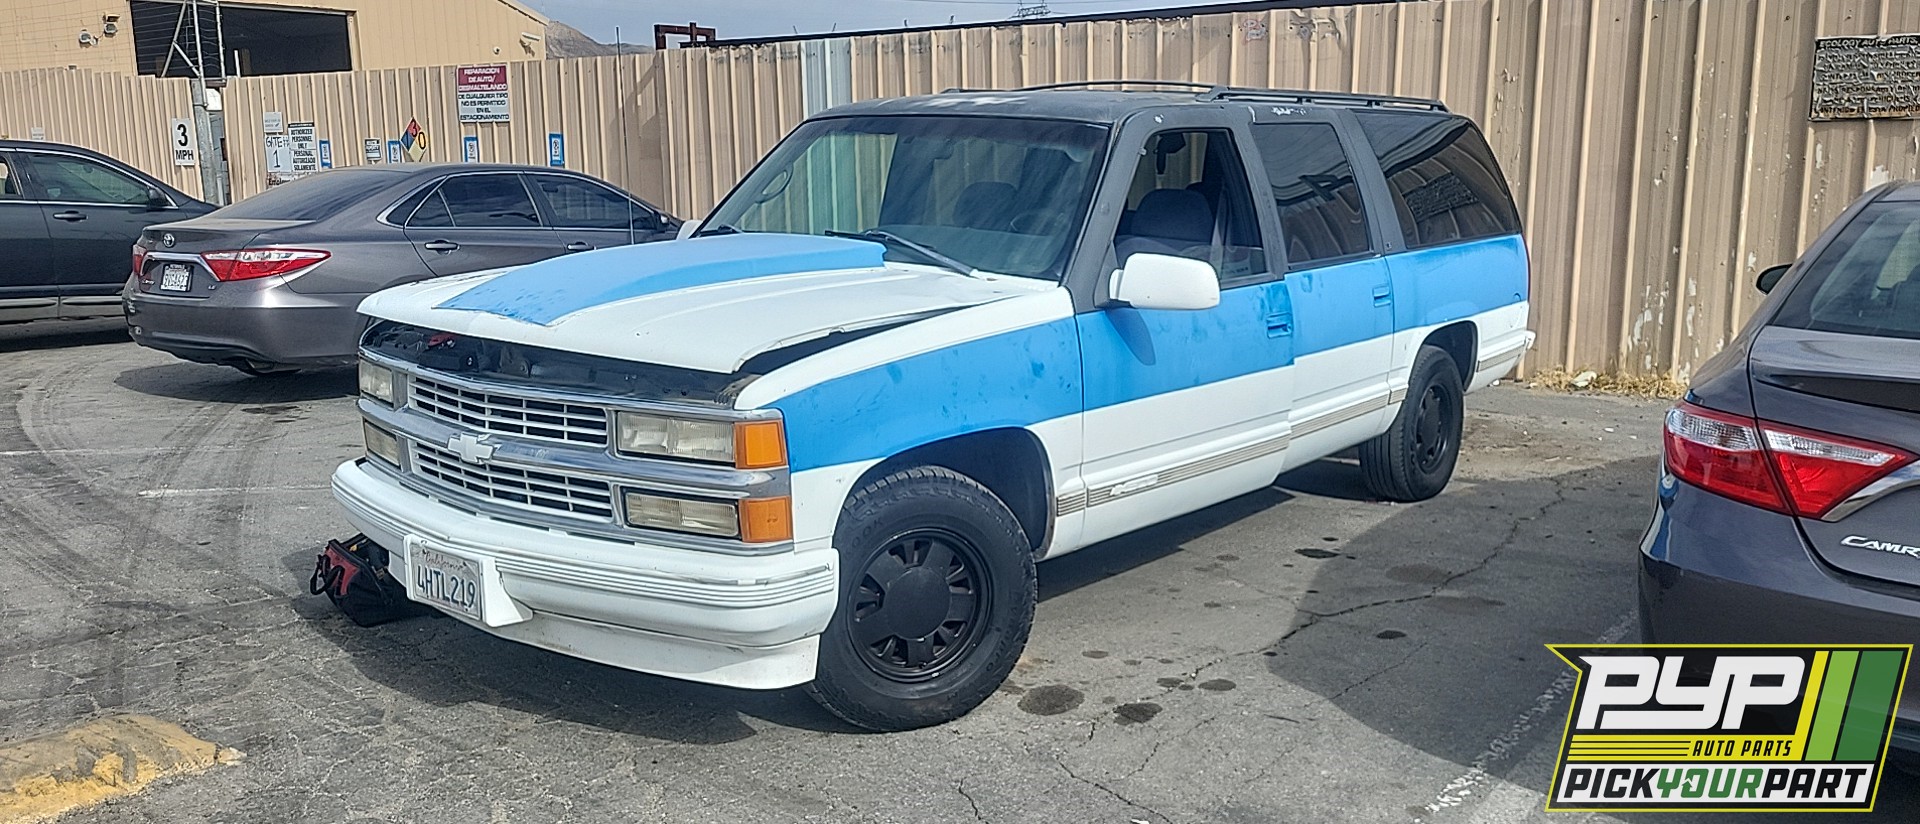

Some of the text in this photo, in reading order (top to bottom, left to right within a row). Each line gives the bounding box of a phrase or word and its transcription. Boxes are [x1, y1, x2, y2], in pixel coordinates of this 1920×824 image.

[1819, 40, 1860, 48] ECOLOGY
[177, 123, 188, 147] 3
[411, 119, 418, 137] 3
[418, 131, 426, 150] 0
[175, 149, 194, 160] MPH
[273, 149, 281, 168] 1
[417, 565, 476, 608] 4HTL219
